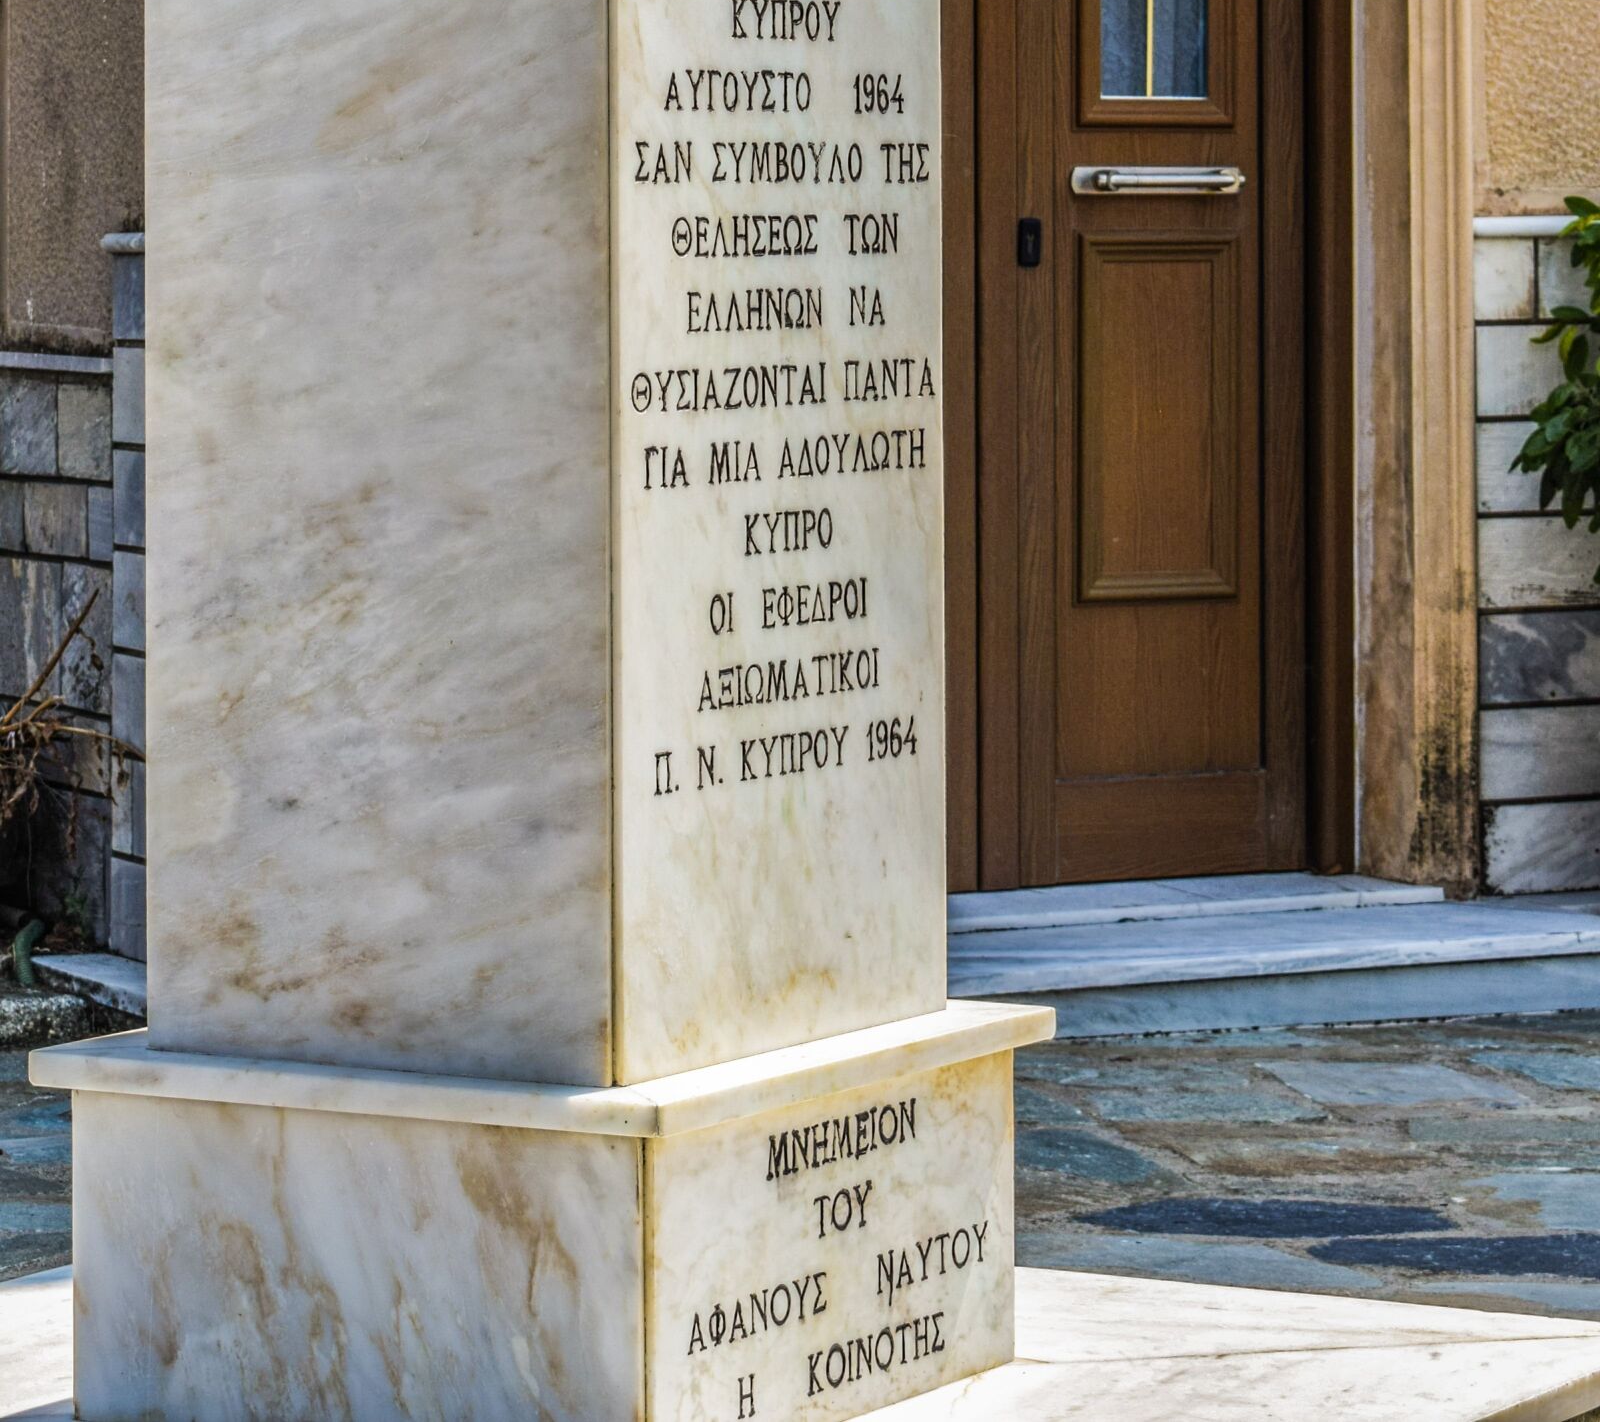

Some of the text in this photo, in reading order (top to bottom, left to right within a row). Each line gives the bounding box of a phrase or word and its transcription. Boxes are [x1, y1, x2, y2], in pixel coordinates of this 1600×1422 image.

[663, 69, 905, 115] ΑΥΓΟΥΣΤΟ 1964
[634, 140, 930, 185] ΣΑΝ ΣΥΜΒΟΥΛΟ ΤΗΣ
[671, 212, 899, 258] ΘΕΛΗΣΕΩΣ ΤΩΝ
[686, 285, 886, 334] ΕΛΛΗΝΩΝ ΝΑ
[631, 357, 936, 413] ΘΥΣΙΑΖΟΝΤΑΙ ΠΑΝΤΑ
[643, 427, 926, 490] ΓΙΑ ΜΙΑ ΑΔΟΥΛΩΤΗ
[744, 507, 833, 557] ΚΥΠΡΟ
[709, 577, 867, 636] ΟΙ ΕΦΕΔΡΟΙ
[697, 647, 880, 713] ΑΞΙΩΜΑΤΙΚΟΙ
[654, 715, 918, 796] Π. Ν. ΚΥΠΡΟΥ 1964
[766, 1097, 917, 1181] ΜΝΗΜΕΙΟΝ
[813, 1179, 873, 1239] ΤΟΥ
[687, 1220, 988, 1355] ΑΦΑΝΟΥΣ ΝΑΥΤΟΥ
[737, 1312, 945, 1420] Η ΚΟΙΝΟΤΗΣ
